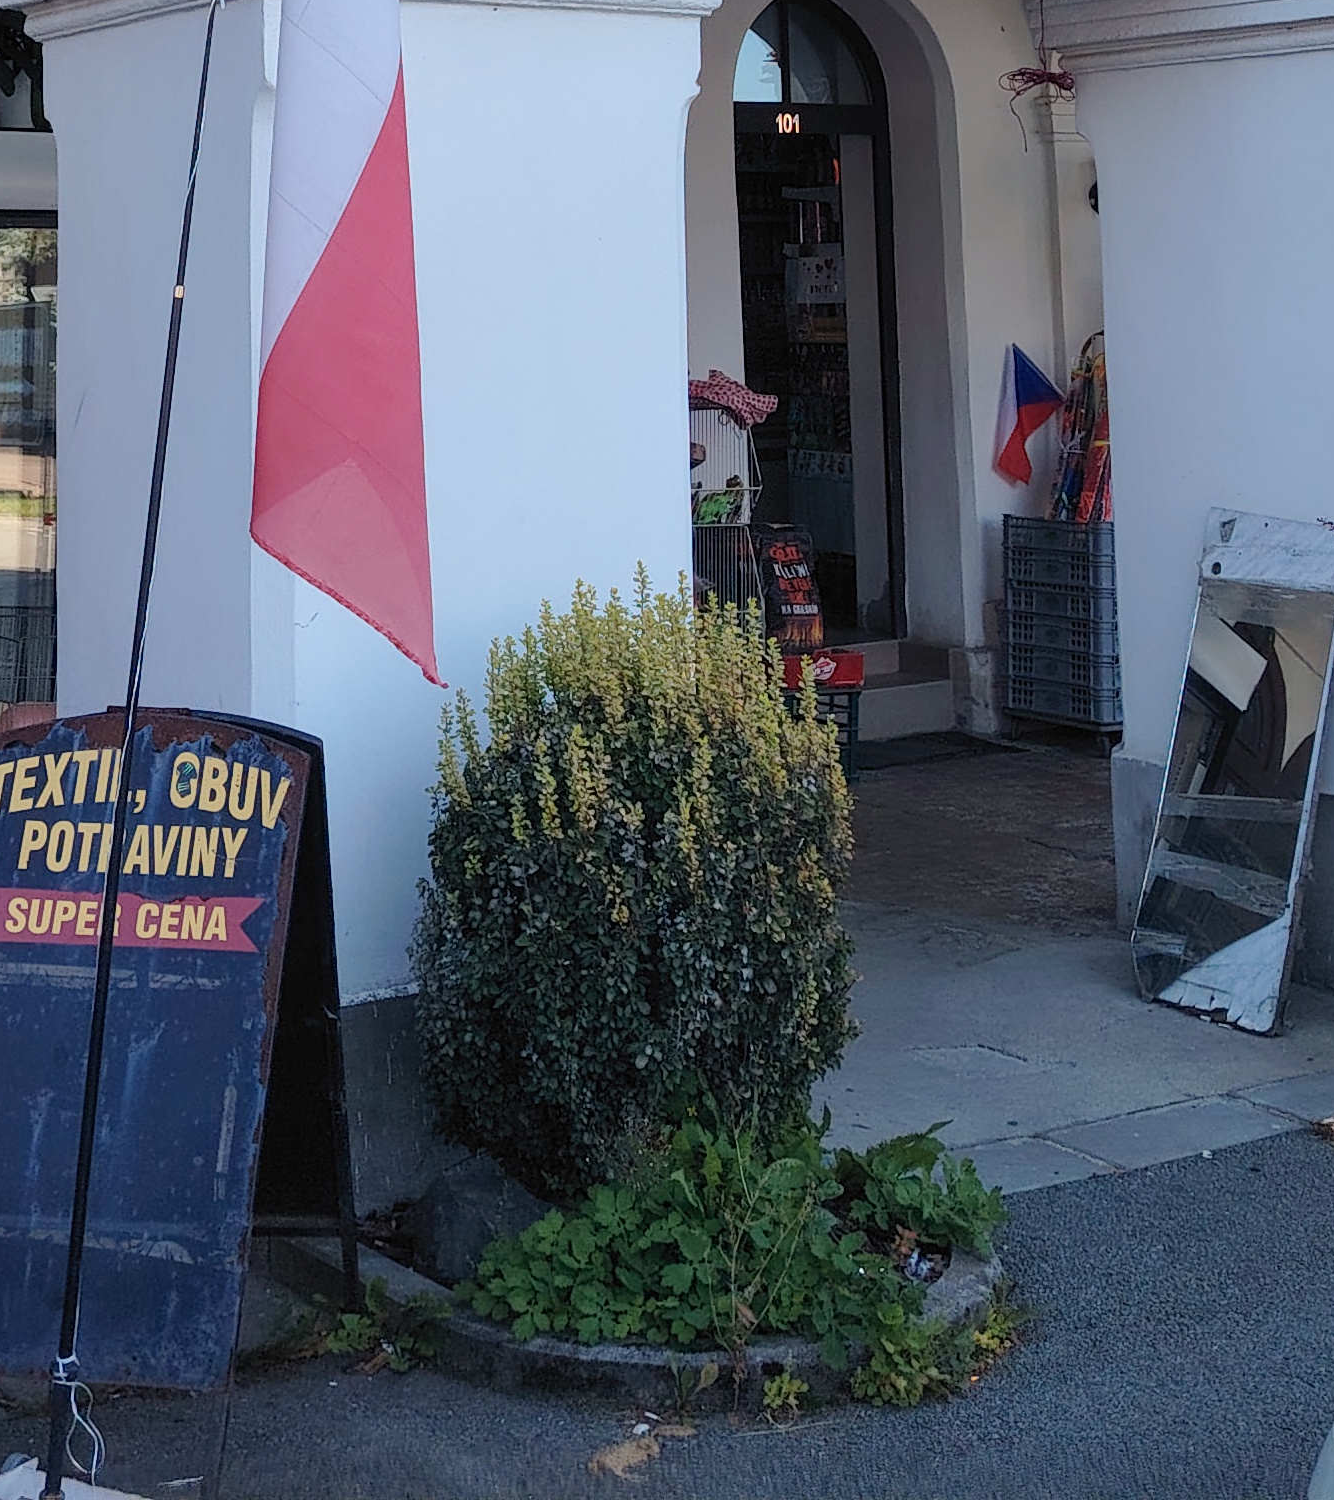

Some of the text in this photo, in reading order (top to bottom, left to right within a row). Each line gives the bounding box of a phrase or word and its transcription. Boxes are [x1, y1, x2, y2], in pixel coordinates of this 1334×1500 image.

[775, 112, 801, 135] 101
[170, 751, 292, 831] OBUV
[135, 902, 228, 942] CENA
